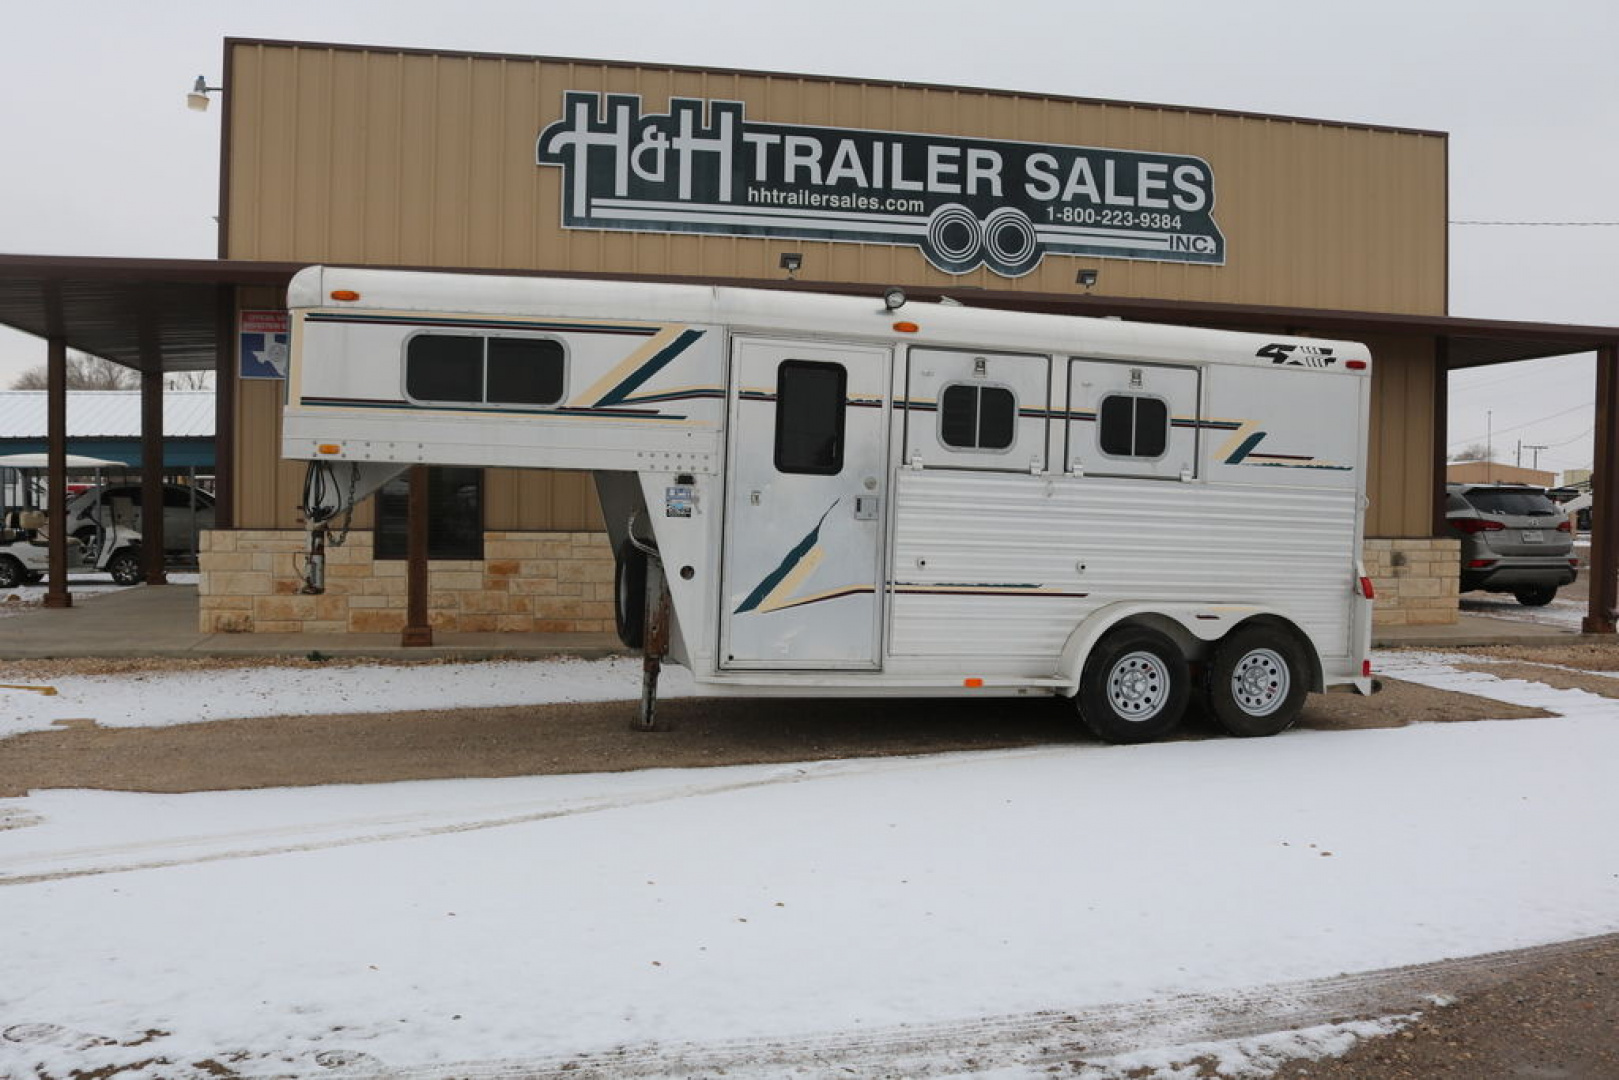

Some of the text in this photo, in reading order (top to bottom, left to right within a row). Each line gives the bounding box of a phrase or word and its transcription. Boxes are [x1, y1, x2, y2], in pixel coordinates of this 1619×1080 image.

[547, 102, 1206, 218] H&H TRAILER SALES
[747, 187, 924, 213] hhtrailersales.com
[1047, 207, 1182, 230] 1-800-223-9384
[1168, 234, 1216, 254] INC.
